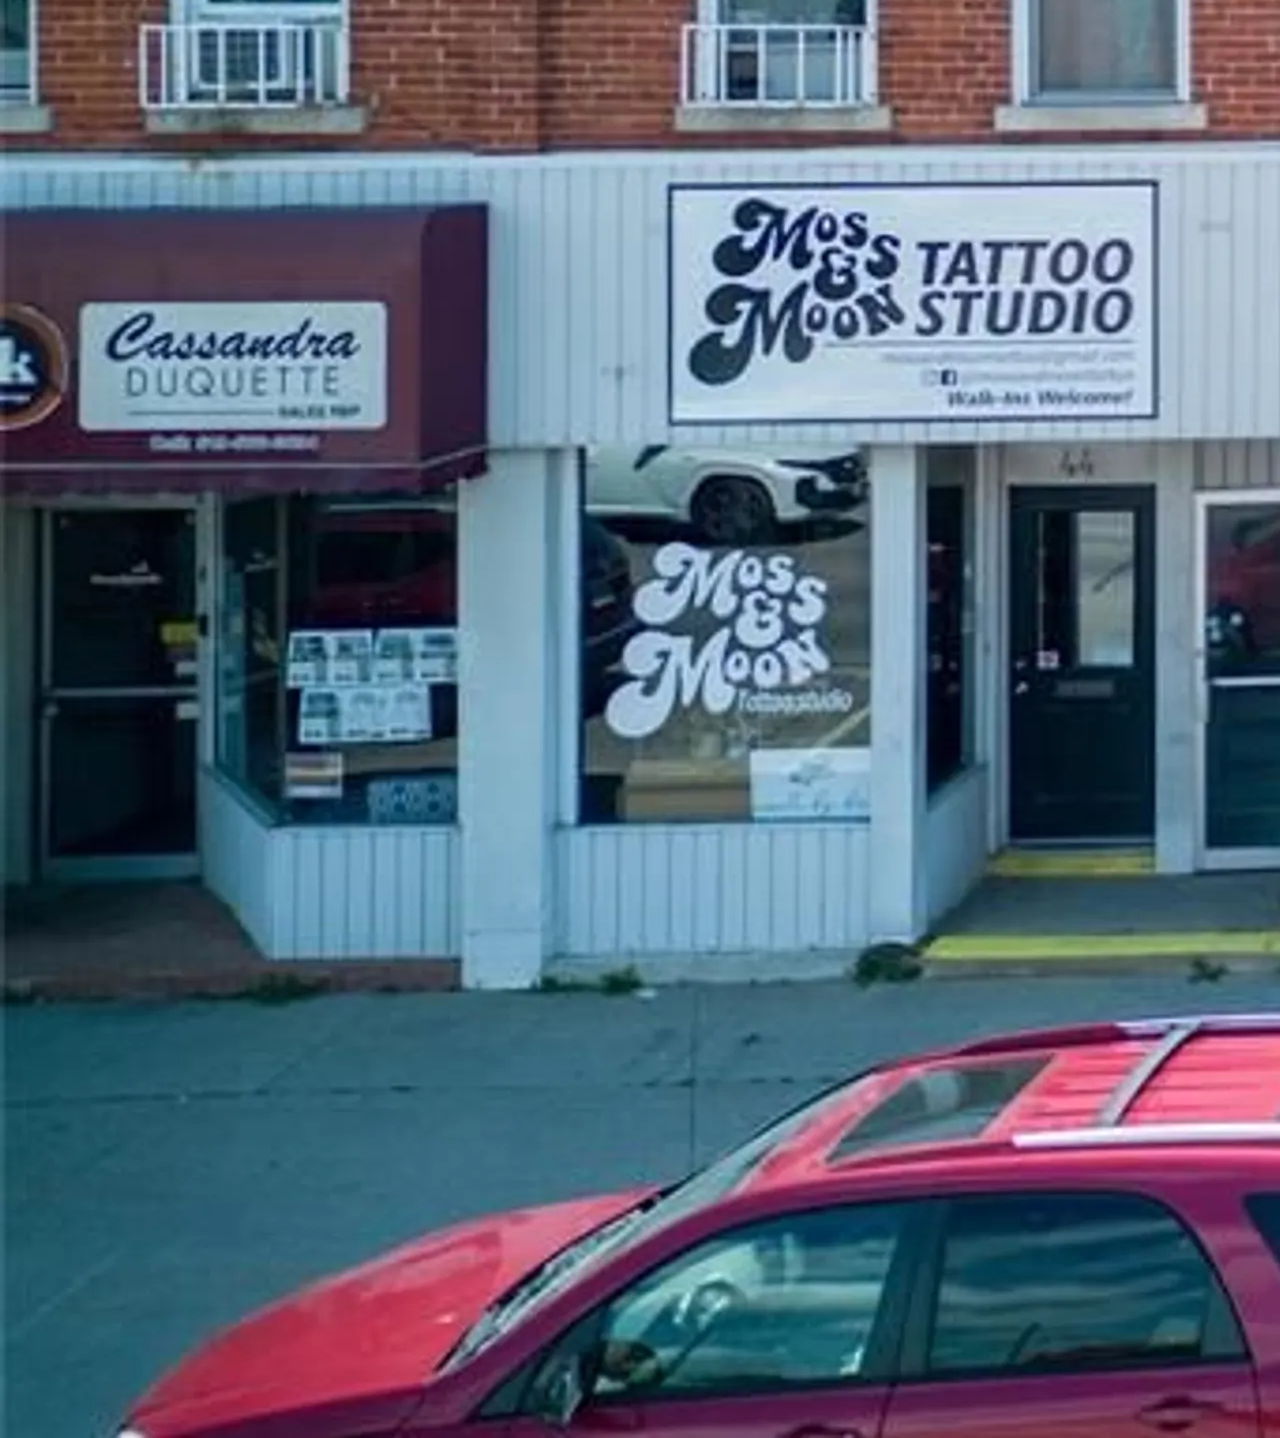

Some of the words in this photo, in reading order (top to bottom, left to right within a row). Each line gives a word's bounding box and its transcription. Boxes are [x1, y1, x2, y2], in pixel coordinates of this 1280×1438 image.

[712, 198, 901, 277] Moss
[916, 239, 1134, 286] TATTOO
[814, 245, 858, 302] &
[105, 311, 361, 363] Cassandra
[687, 282, 906, 386] Moon
[914, 289, 1134, 337] STUDIO
[126, 366, 341, 398] DUQUETTE
[632, 541, 827, 626] Moss
[604, 626, 831, 739] Moon
